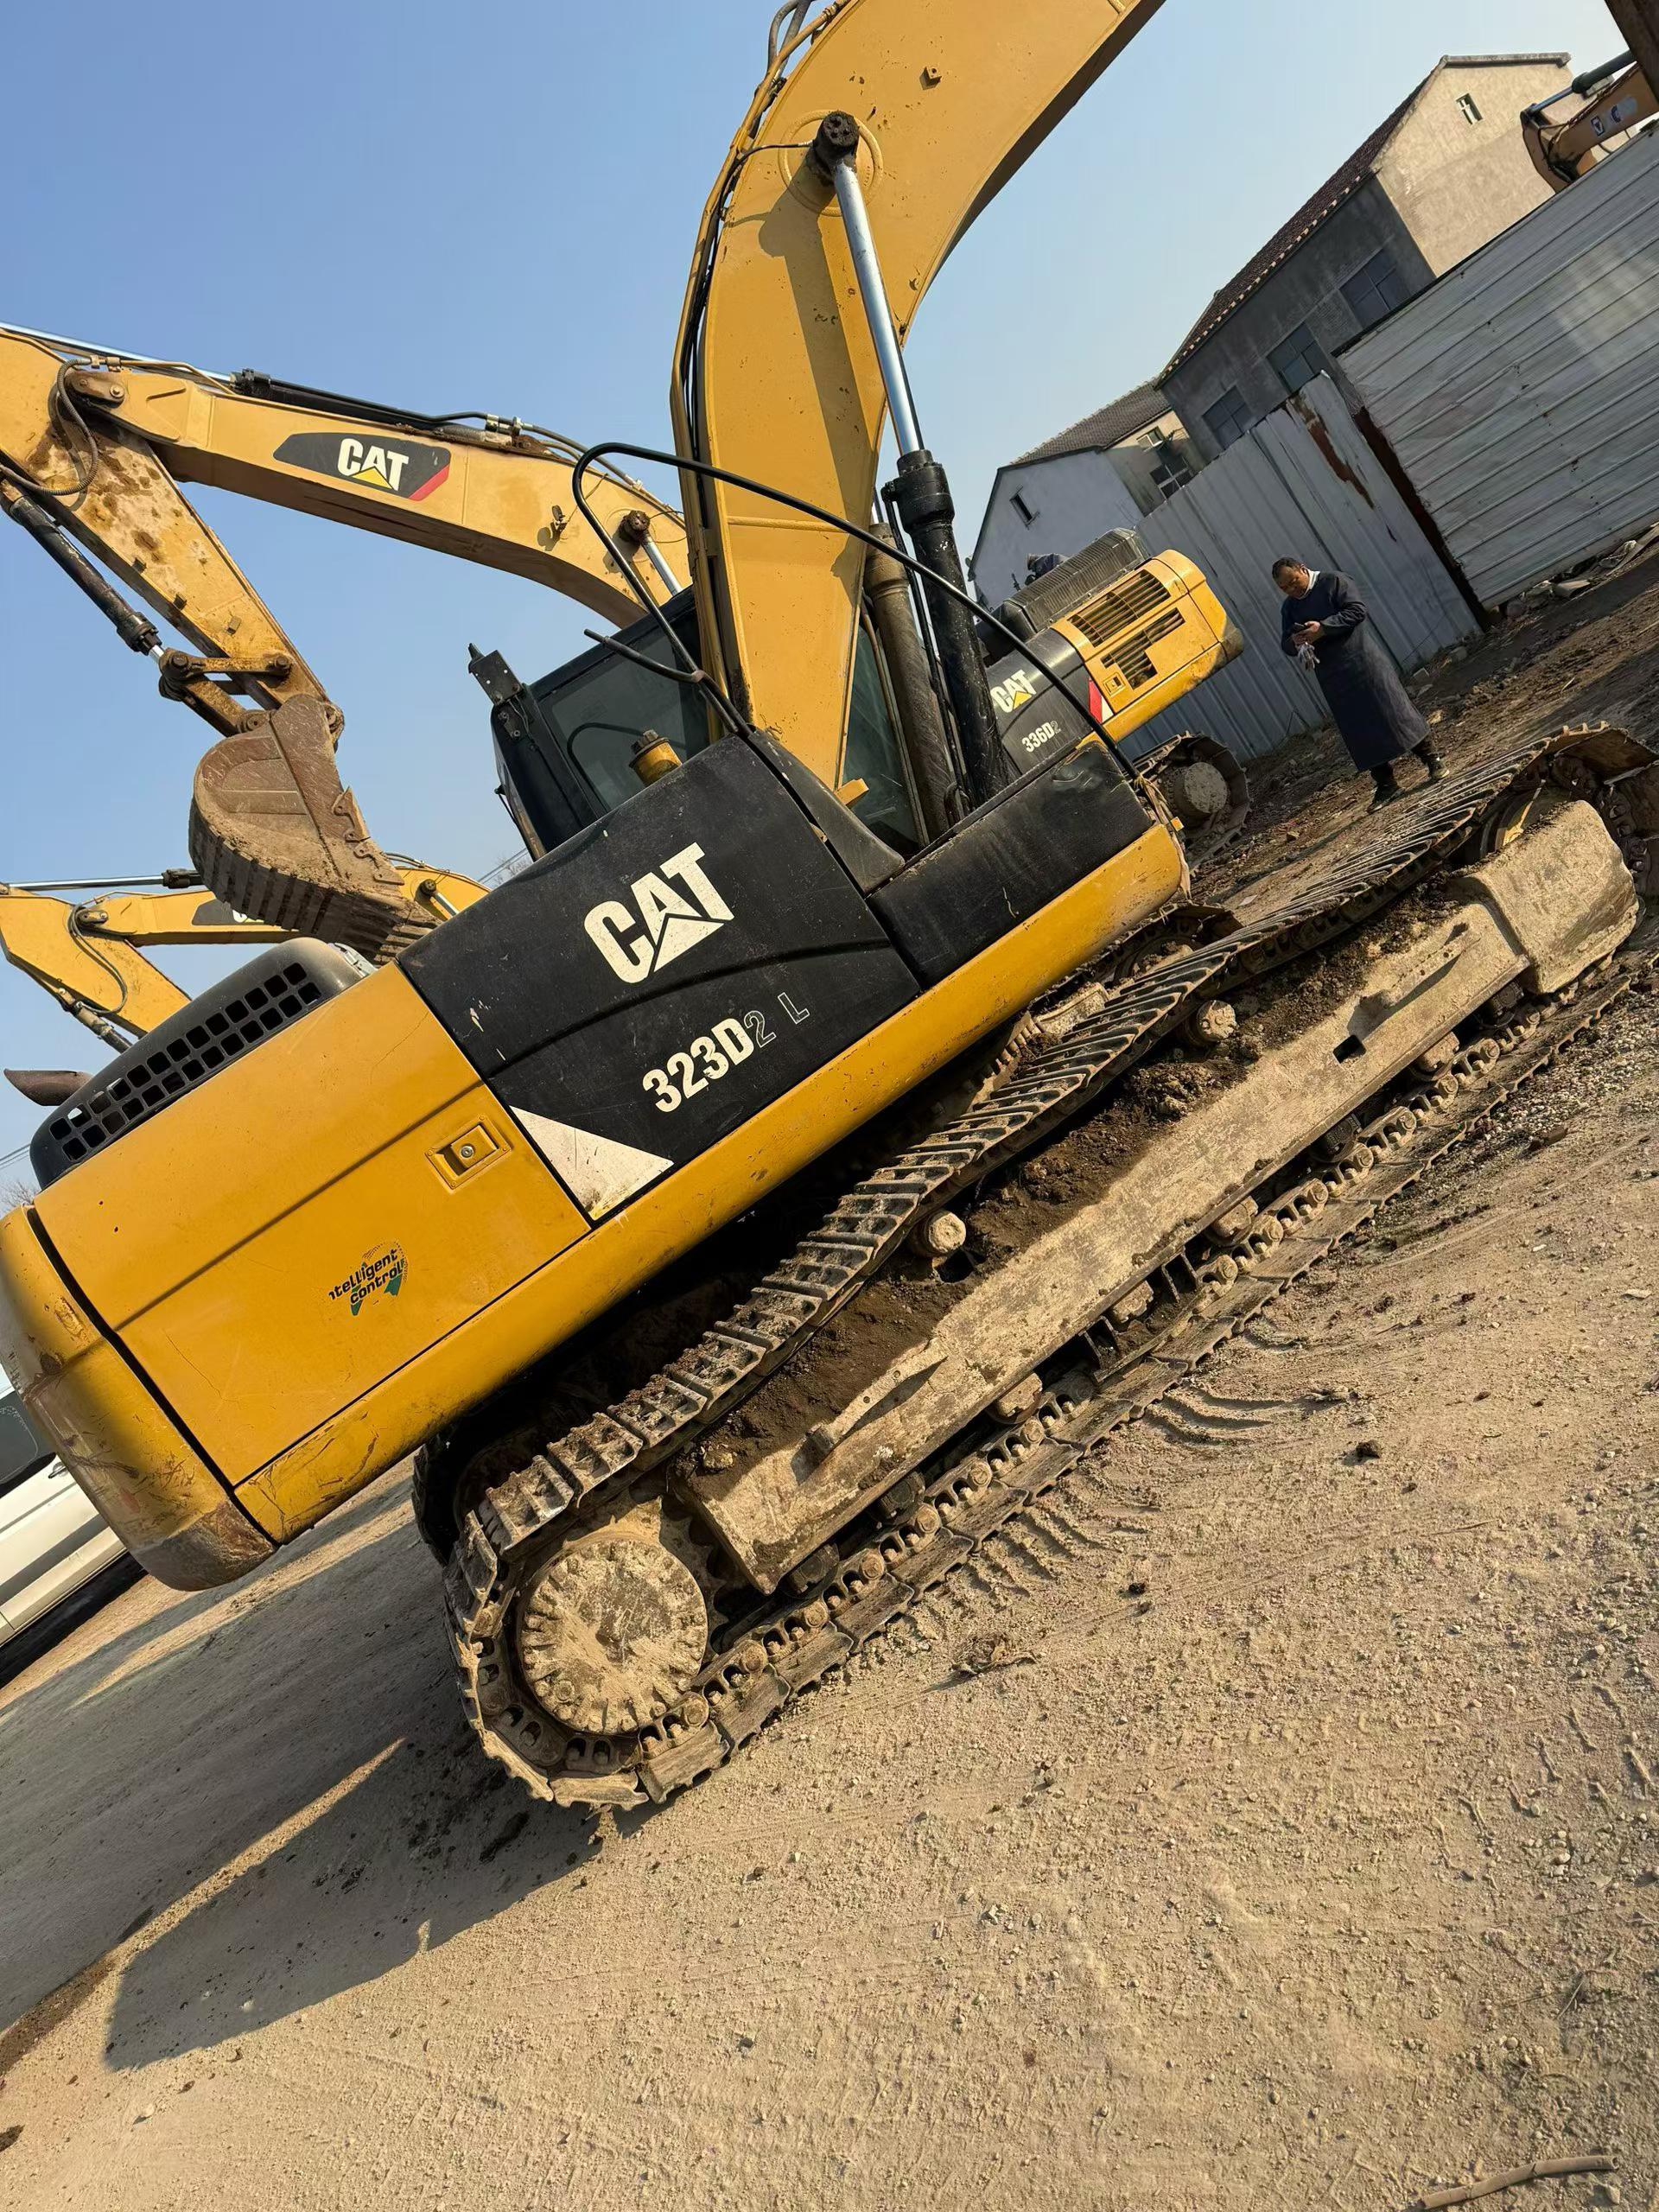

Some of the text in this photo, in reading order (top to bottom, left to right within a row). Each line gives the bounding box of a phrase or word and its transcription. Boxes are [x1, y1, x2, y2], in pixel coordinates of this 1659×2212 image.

[337, 438, 410, 492] CAT
[989, 669, 1037, 713] CAT
[583, 842, 734, 983] CAT
[778, 992, 810, 1025] L
